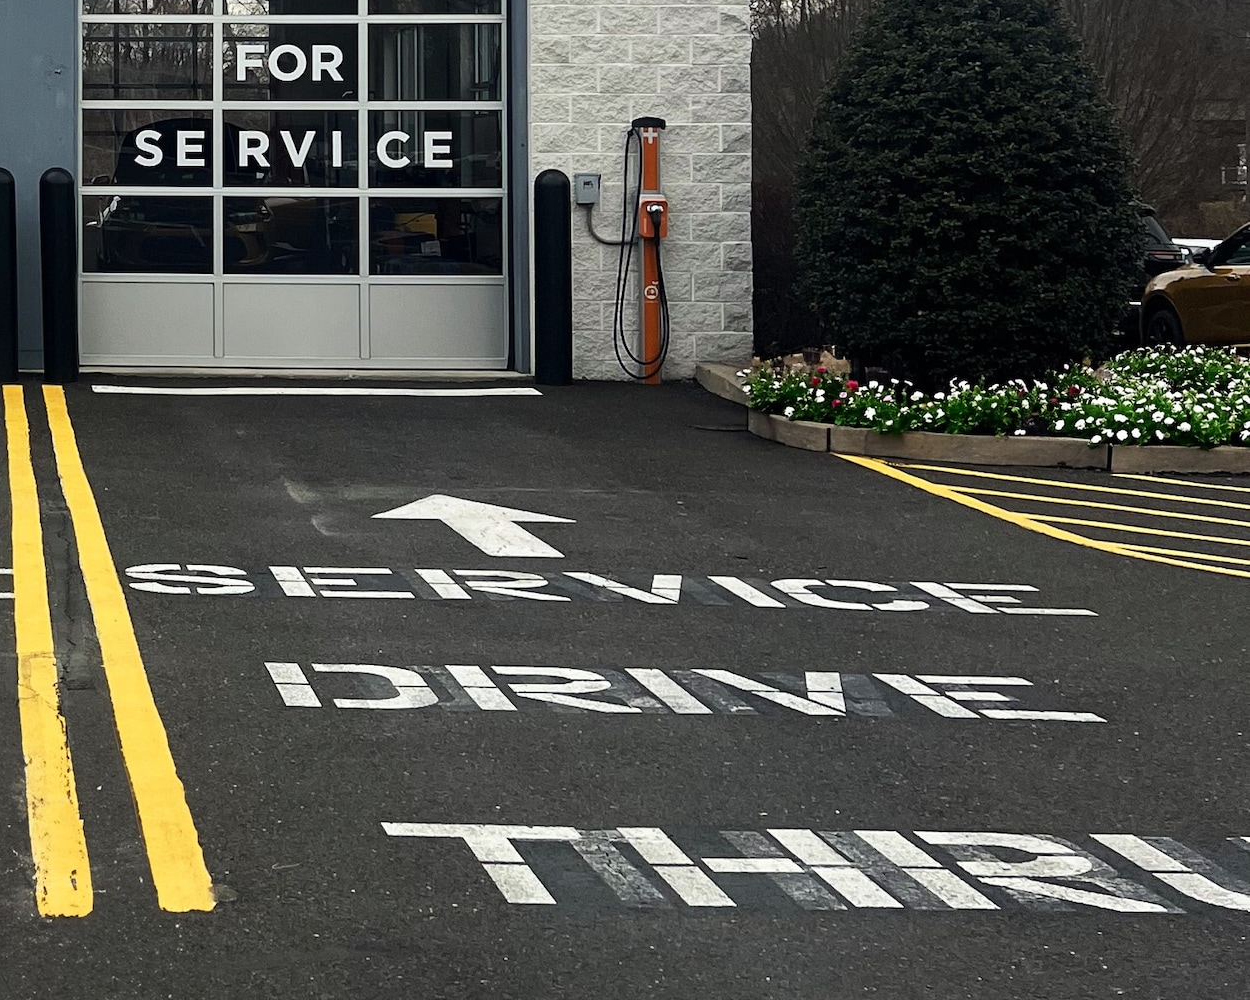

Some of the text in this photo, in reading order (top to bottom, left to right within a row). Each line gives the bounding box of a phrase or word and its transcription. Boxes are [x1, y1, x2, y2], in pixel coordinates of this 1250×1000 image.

[236, 44, 344, 82] FOR
[133, 130, 453, 169] SERVICE
[125, 563, 1100, 616] SERVICE
[263, 661, 1108, 722] DRIVE
